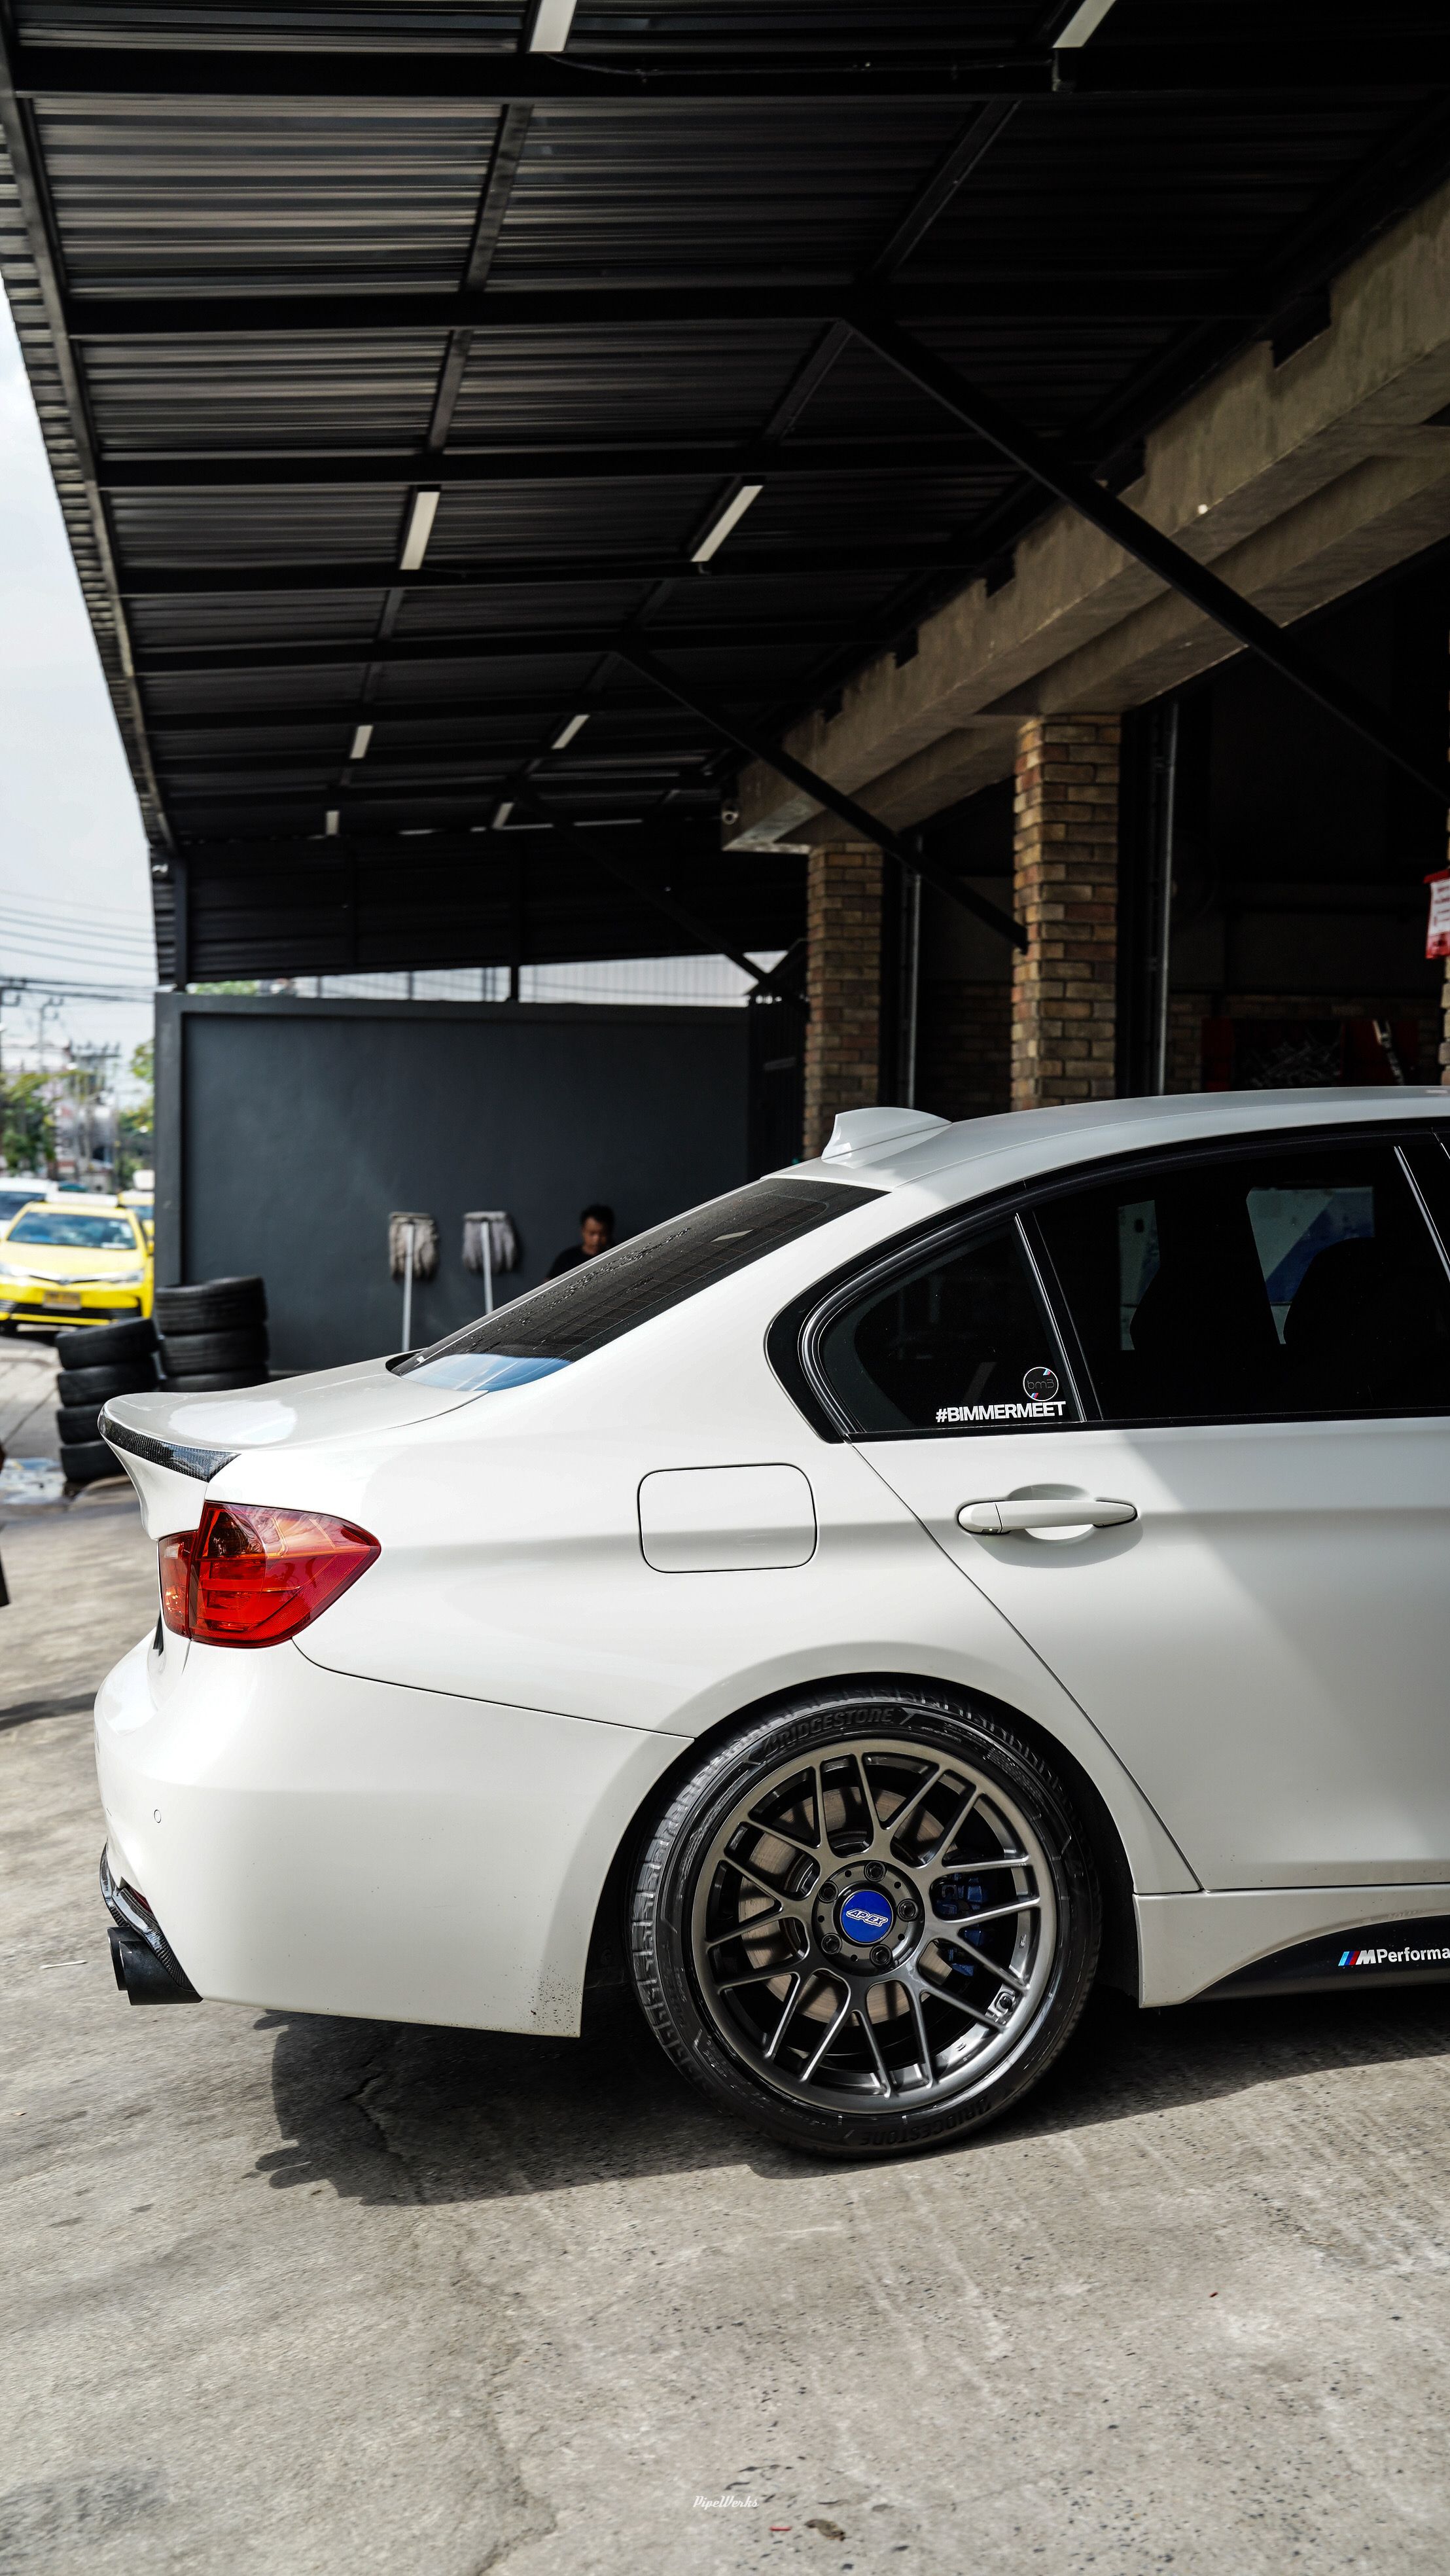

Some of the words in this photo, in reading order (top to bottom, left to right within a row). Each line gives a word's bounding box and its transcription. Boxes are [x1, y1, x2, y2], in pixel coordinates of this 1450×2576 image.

[1027, 1379, 1055, 1389] bm3
[935, 1401, 1067, 1423] #BIMMERMEET
[764, 1708, 893, 1757] BRIDGESTONE
